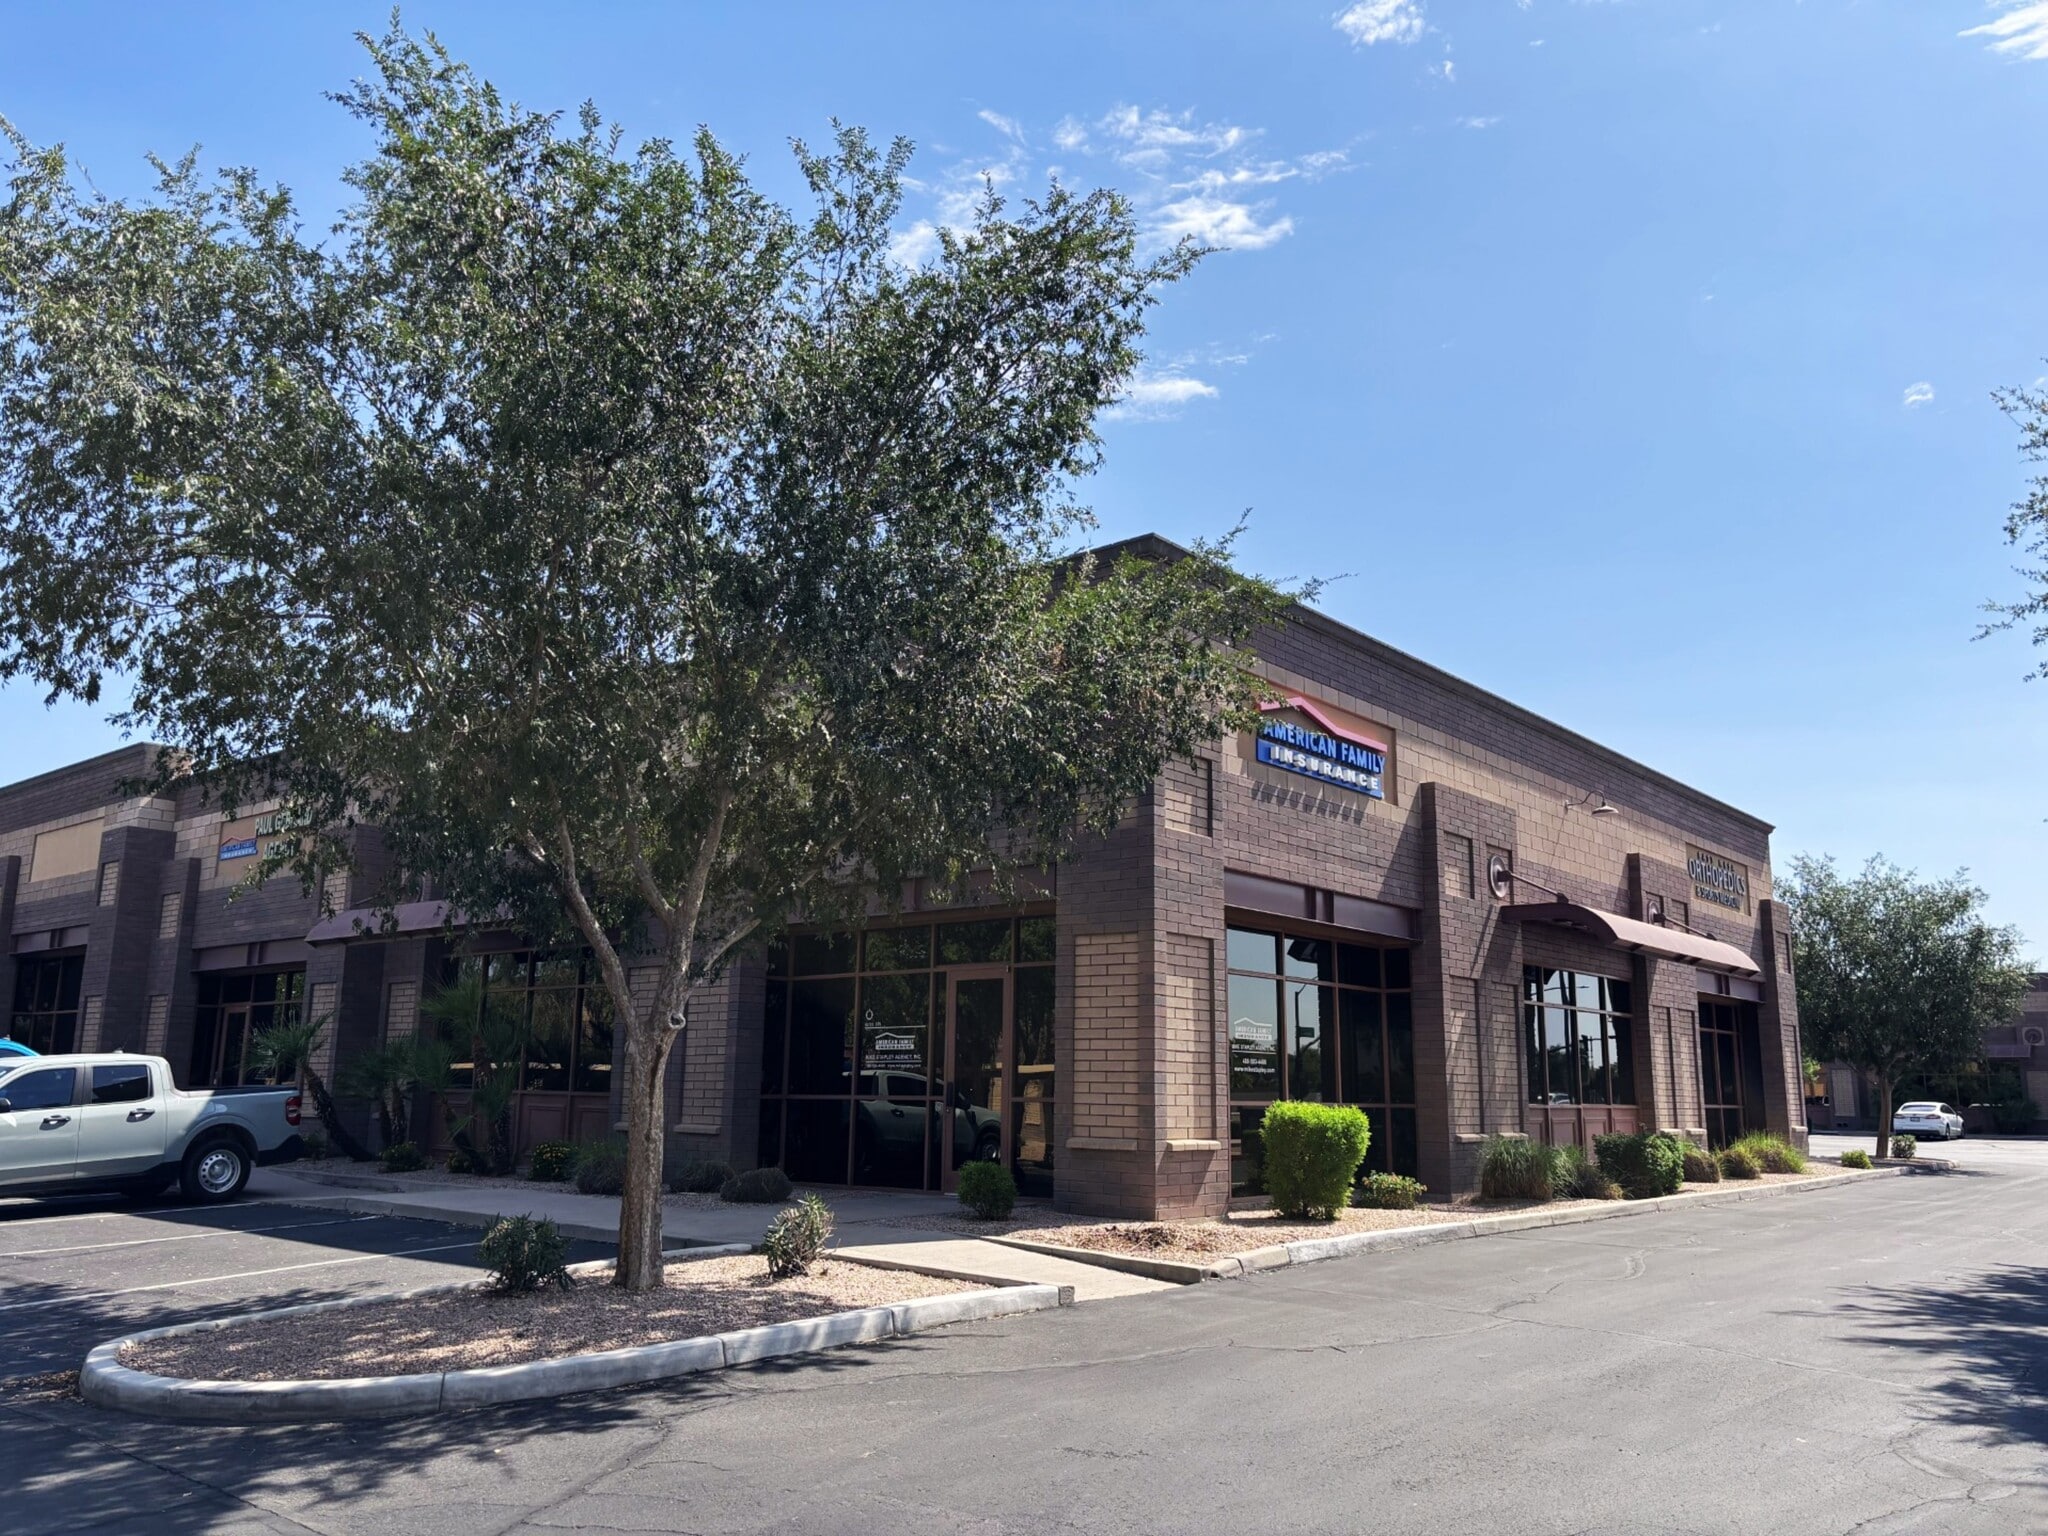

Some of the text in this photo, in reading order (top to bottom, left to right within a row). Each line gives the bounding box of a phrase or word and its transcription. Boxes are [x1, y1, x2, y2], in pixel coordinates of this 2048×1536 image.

[1263, 721, 1386, 775] AMERICAN FAMILY
[1271, 745, 1379, 790] INSURANCE
[255, 815, 273, 836] PAUL
[1687, 857, 1746, 896] ORTHOPEDICS
